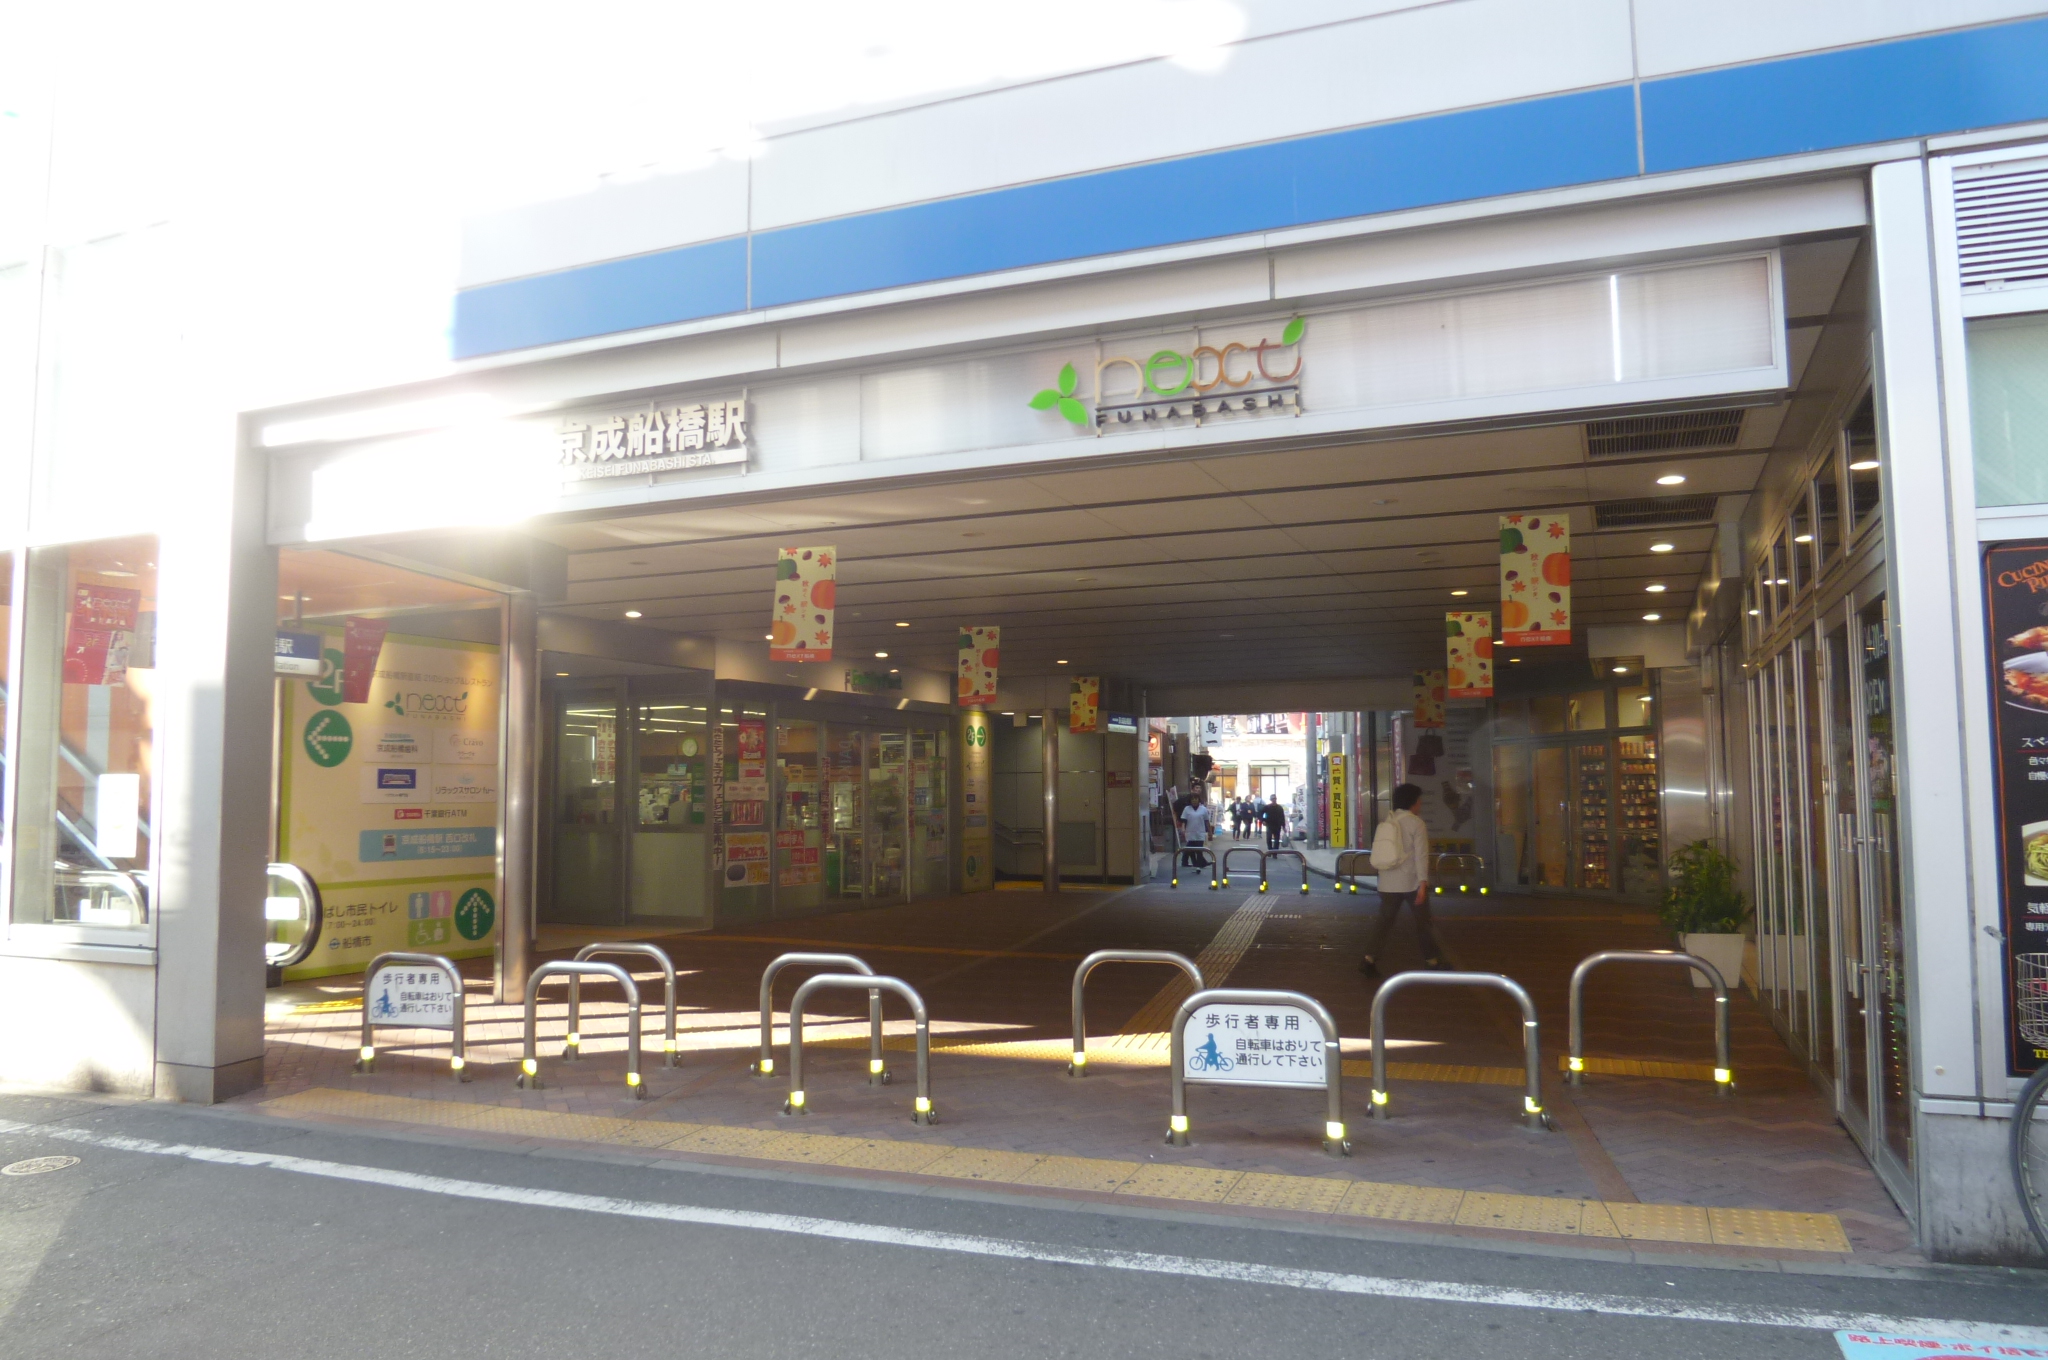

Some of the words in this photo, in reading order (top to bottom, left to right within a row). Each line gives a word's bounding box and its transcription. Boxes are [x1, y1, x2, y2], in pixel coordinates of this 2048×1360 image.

[1095, 392, 1300, 428] FUNABASHI
[556, 400, 747, 466] 京成船橋駅
[619, 457, 686, 474] FUNABASHI
[343, 935, 372, 949] 船橋市
[383, 973, 440, 985] 歩行者専用
[400, 992, 452, 1002] 自転車はおりて
[400, 1003, 452, 1013] 通行して下さい
[1205, 1013, 1300, 1031] 歩行者専用
[1235, 1038, 1322, 1053] 自転車はおりて
[1235, 1053, 1323, 1068] 通行して下さい
